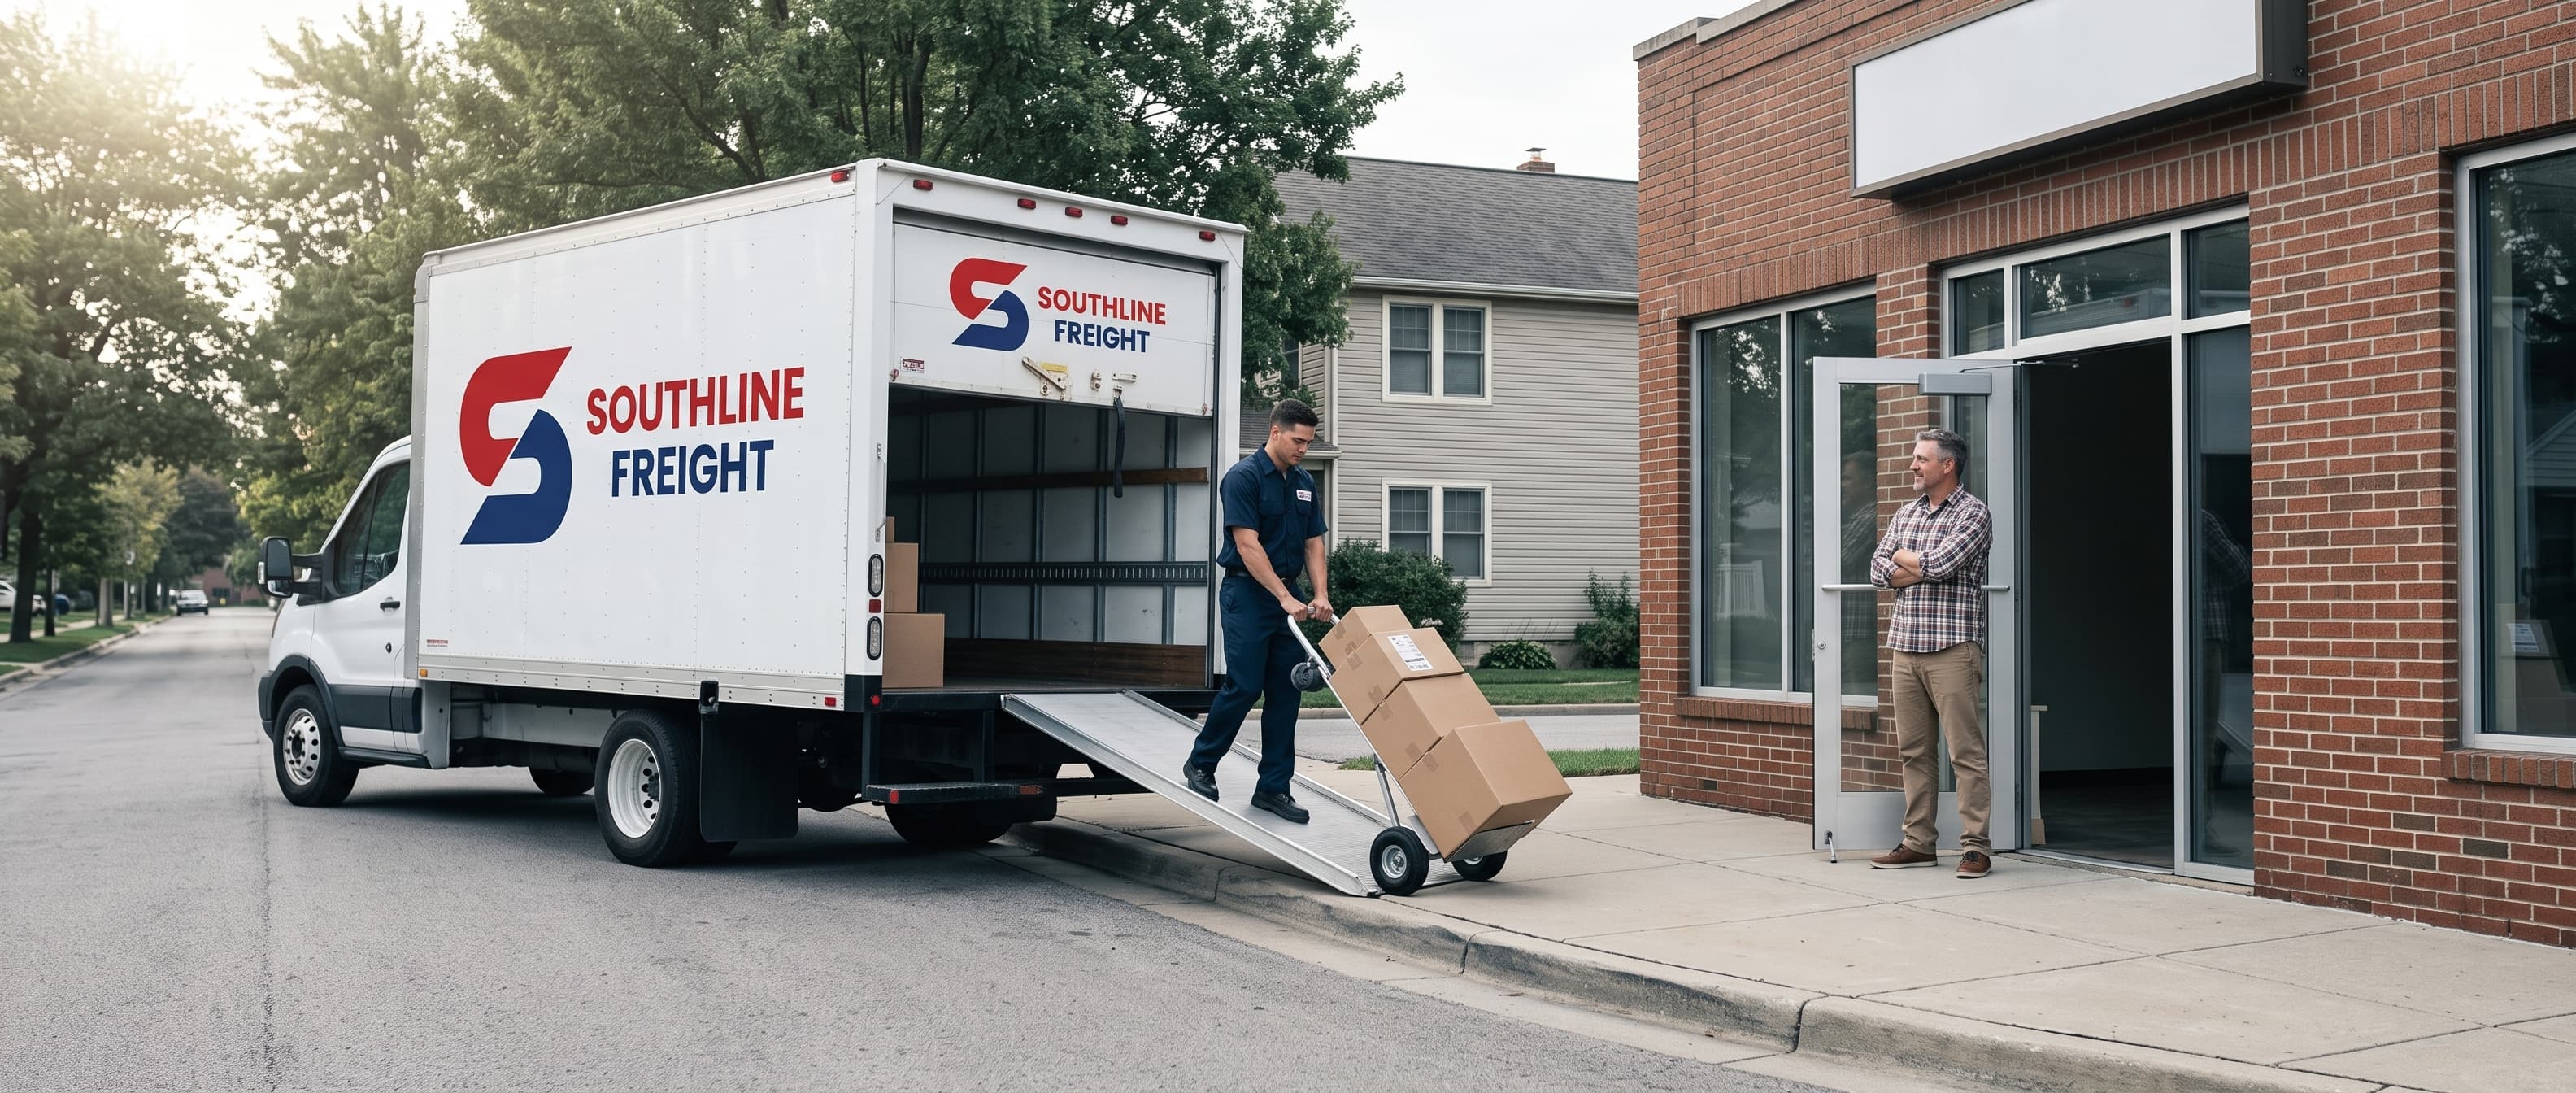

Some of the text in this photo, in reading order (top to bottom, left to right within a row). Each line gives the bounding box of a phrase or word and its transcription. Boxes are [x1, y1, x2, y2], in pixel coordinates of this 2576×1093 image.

[1038, 286, 1167, 325] SOUTHLINE
[1055, 319, 1151, 353] FREIGHT
[586, 367, 805, 436] SOUTHLINE
[611, 439, 775, 498] FREIGHT
